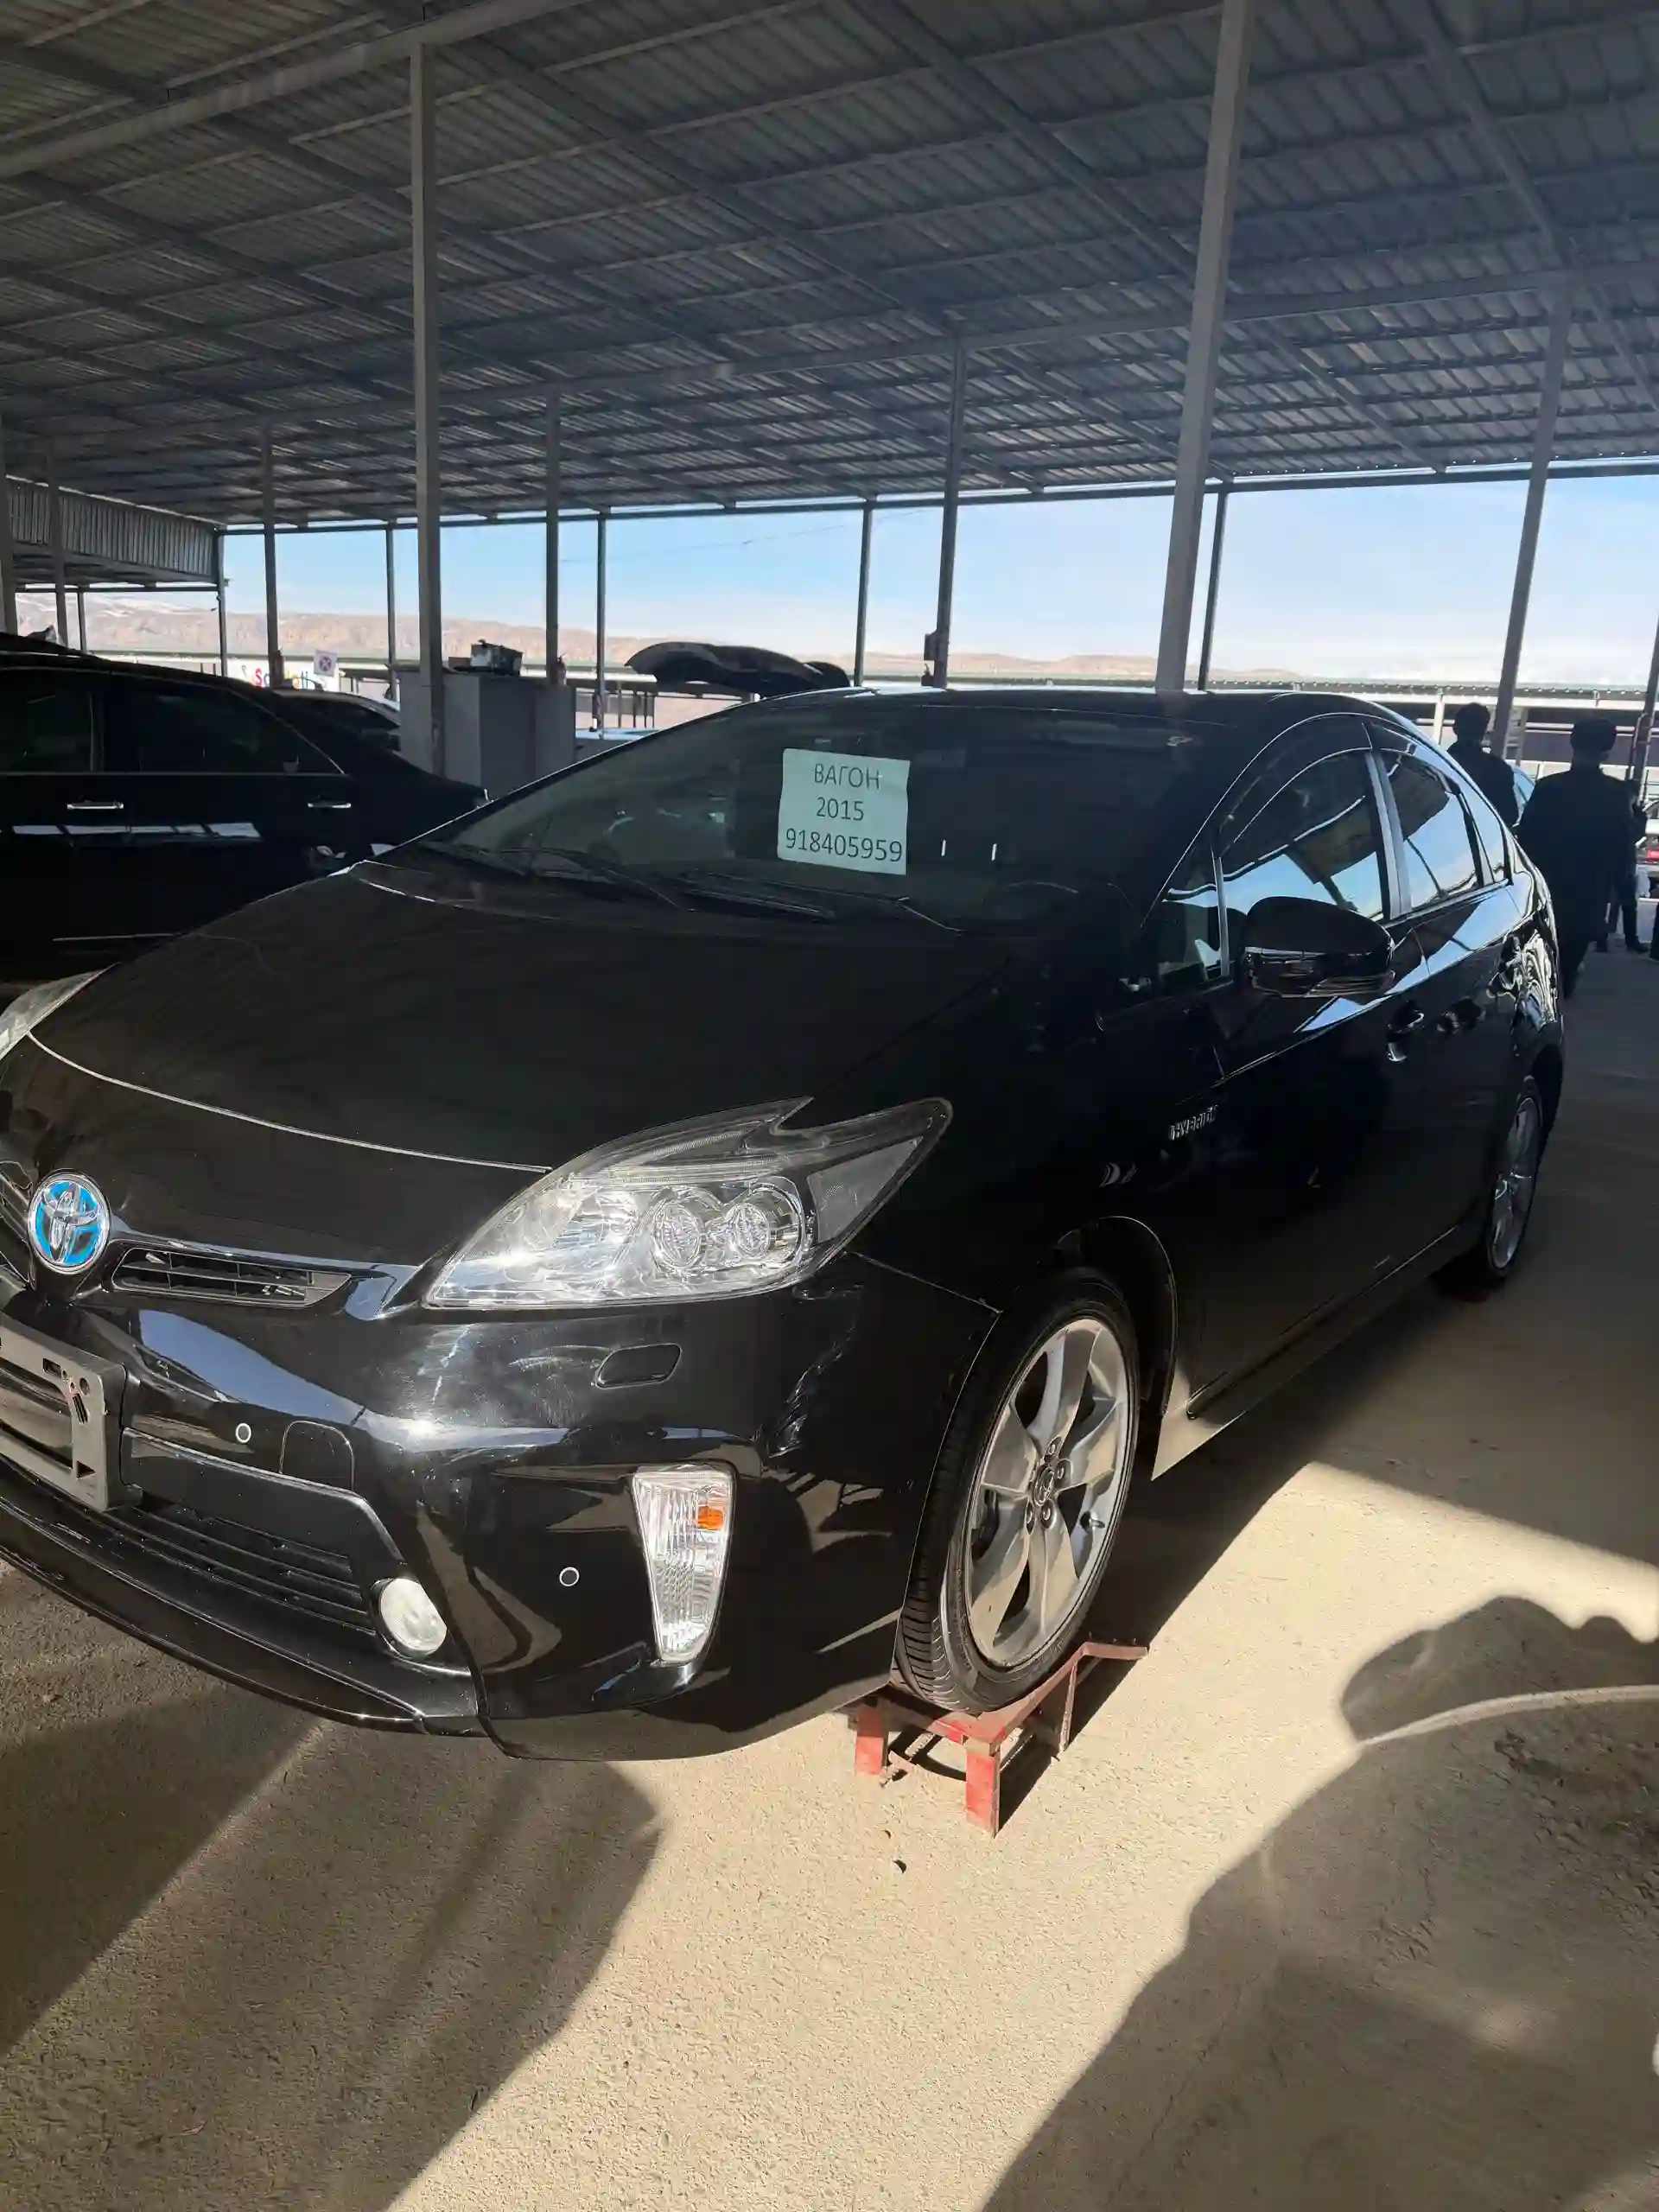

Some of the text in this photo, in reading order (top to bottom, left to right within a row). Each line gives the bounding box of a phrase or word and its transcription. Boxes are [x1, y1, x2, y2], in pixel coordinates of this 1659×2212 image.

[814, 763, 880, 790] ВАГОН
[816, 797, 864, 821] 2015
[785, 828, 902, 862] 918405959
